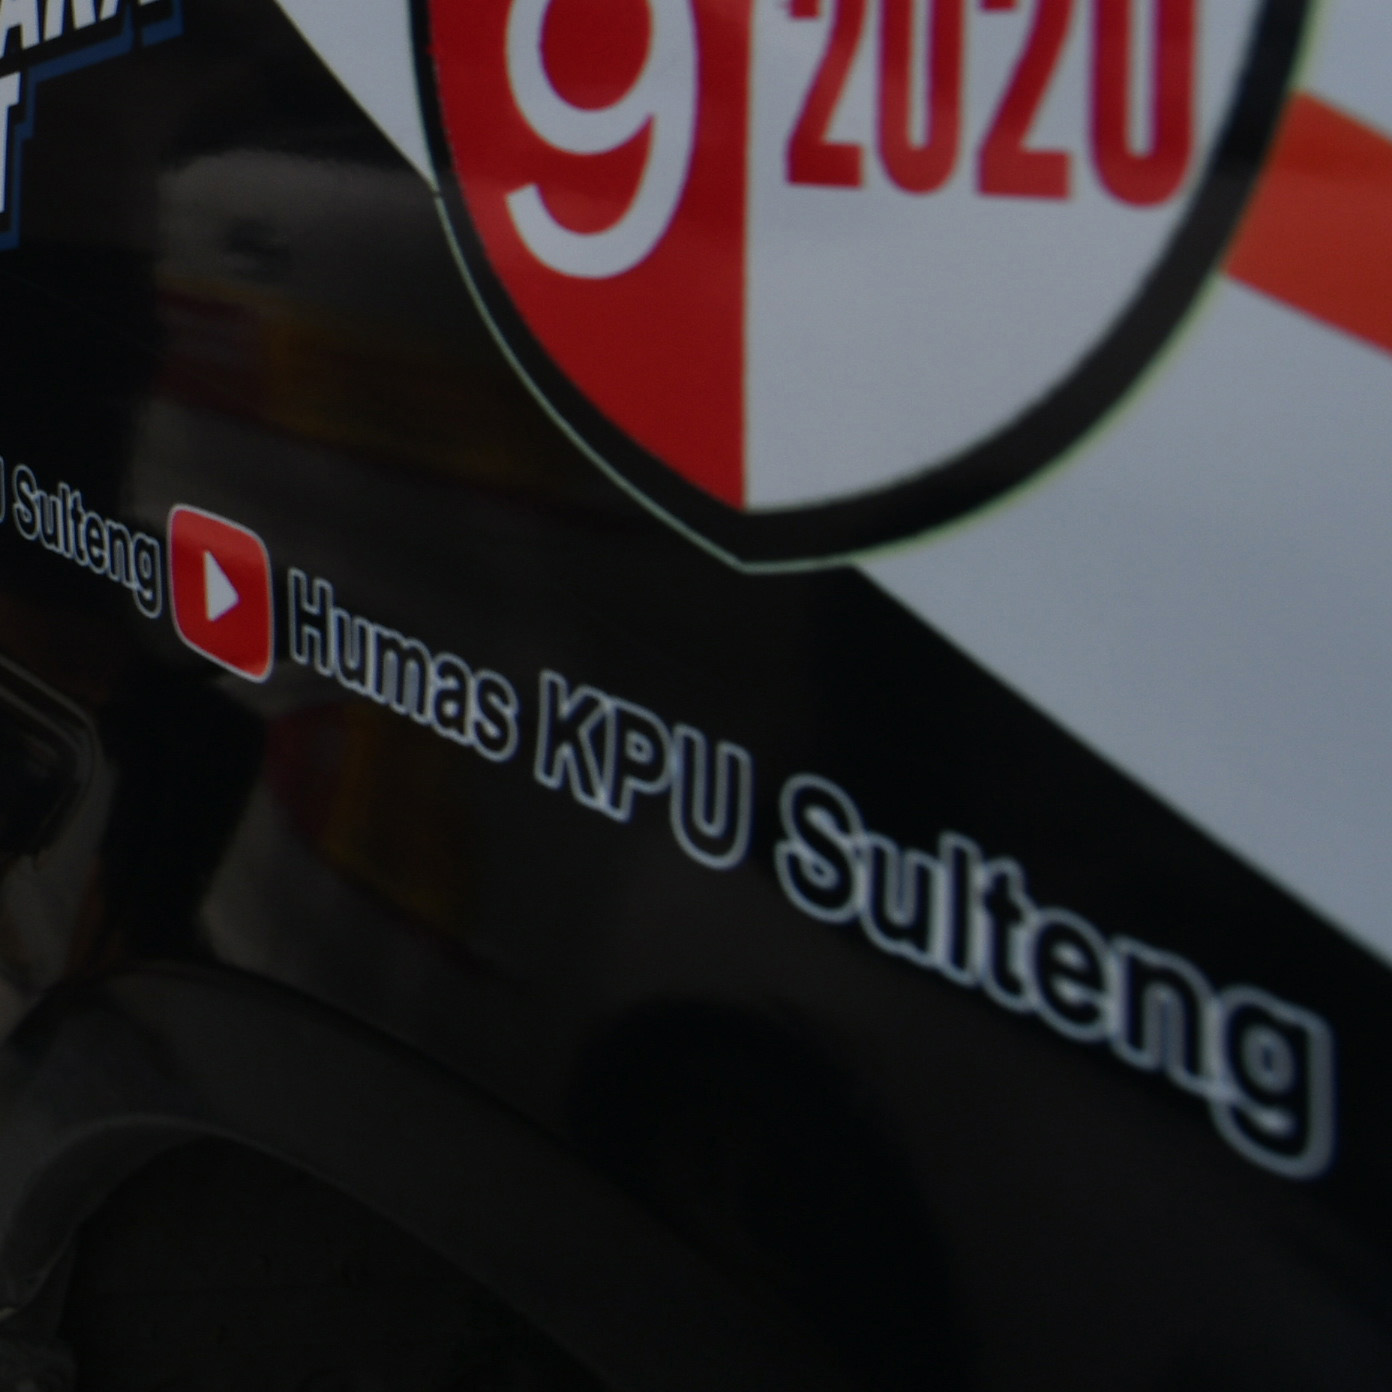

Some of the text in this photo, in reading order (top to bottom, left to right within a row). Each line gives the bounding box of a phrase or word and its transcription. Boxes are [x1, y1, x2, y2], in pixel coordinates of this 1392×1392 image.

[13, 464, 163, 619] Sulteng
[287, 567, 1336, 1179] Humas KPU Sulteng
